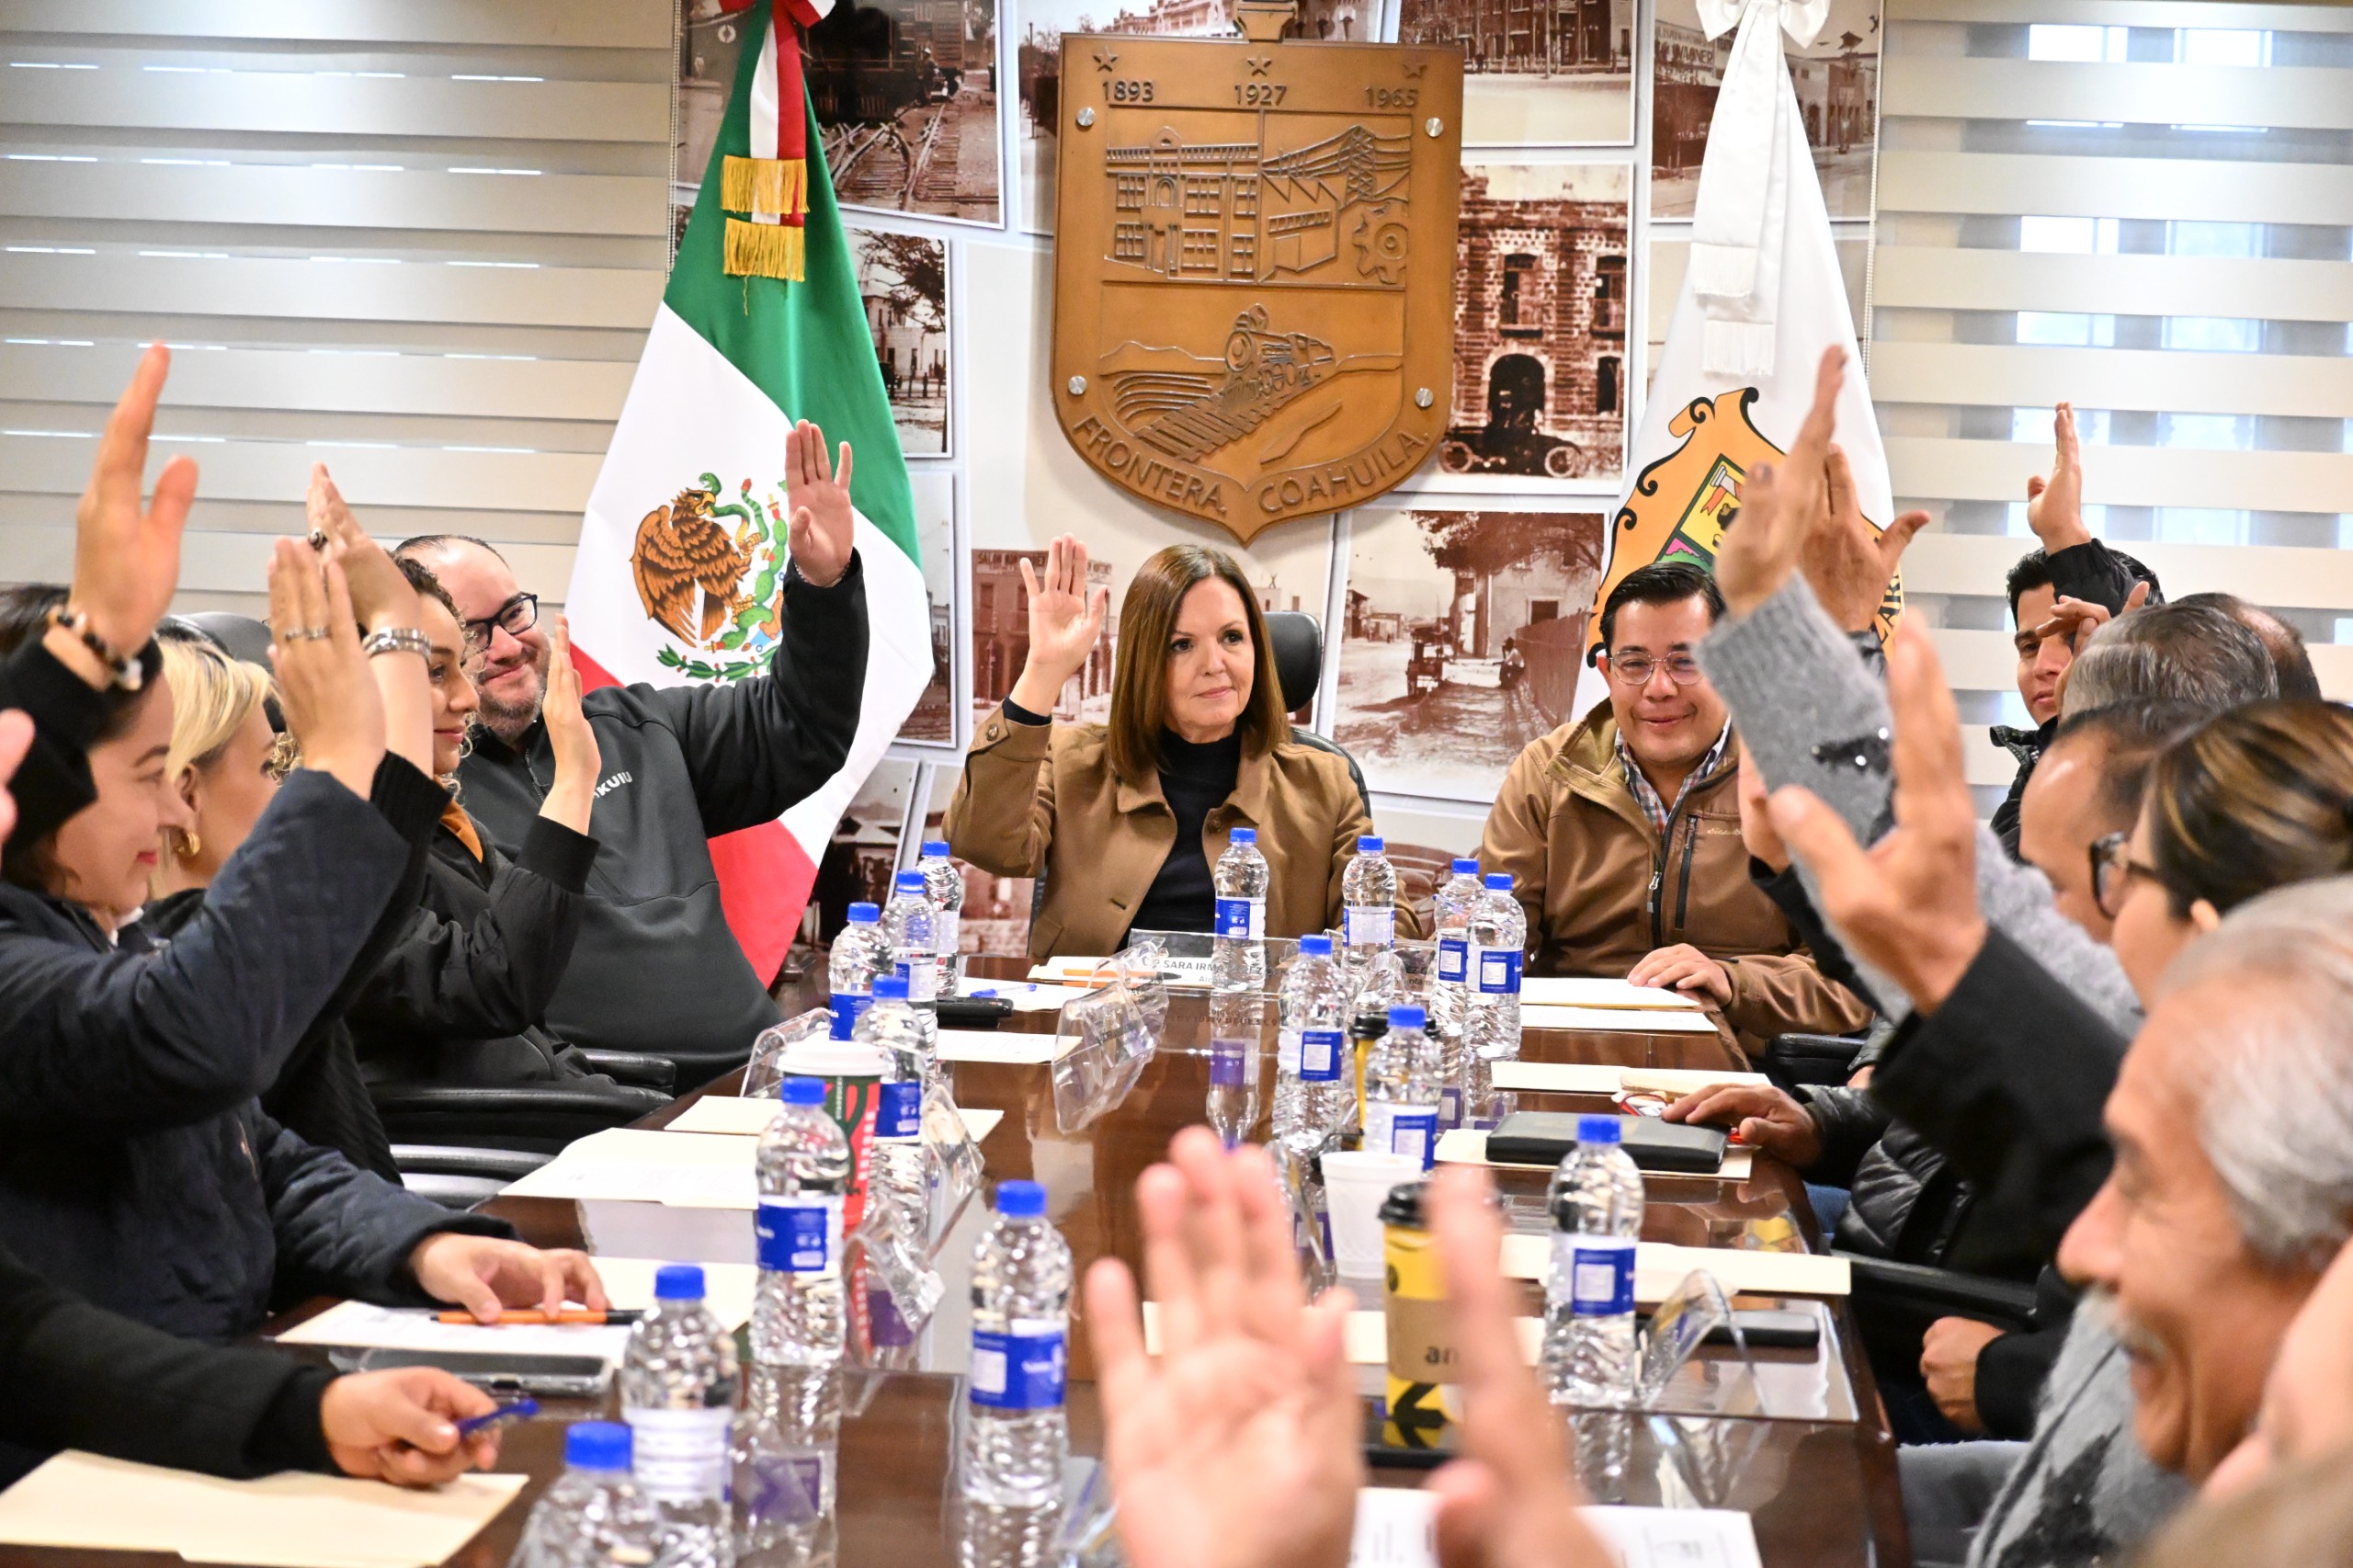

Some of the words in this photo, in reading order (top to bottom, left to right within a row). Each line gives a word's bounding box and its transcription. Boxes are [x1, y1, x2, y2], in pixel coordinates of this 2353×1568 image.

[1103, 80, 1154, 103] 1893
[1234, 83, 1287, 107] 1927
[596, 771, 632, 797] KUIU
[1164, 960, 1194, 971] SARA
[1195, 962, 1225, 974] IRMA
